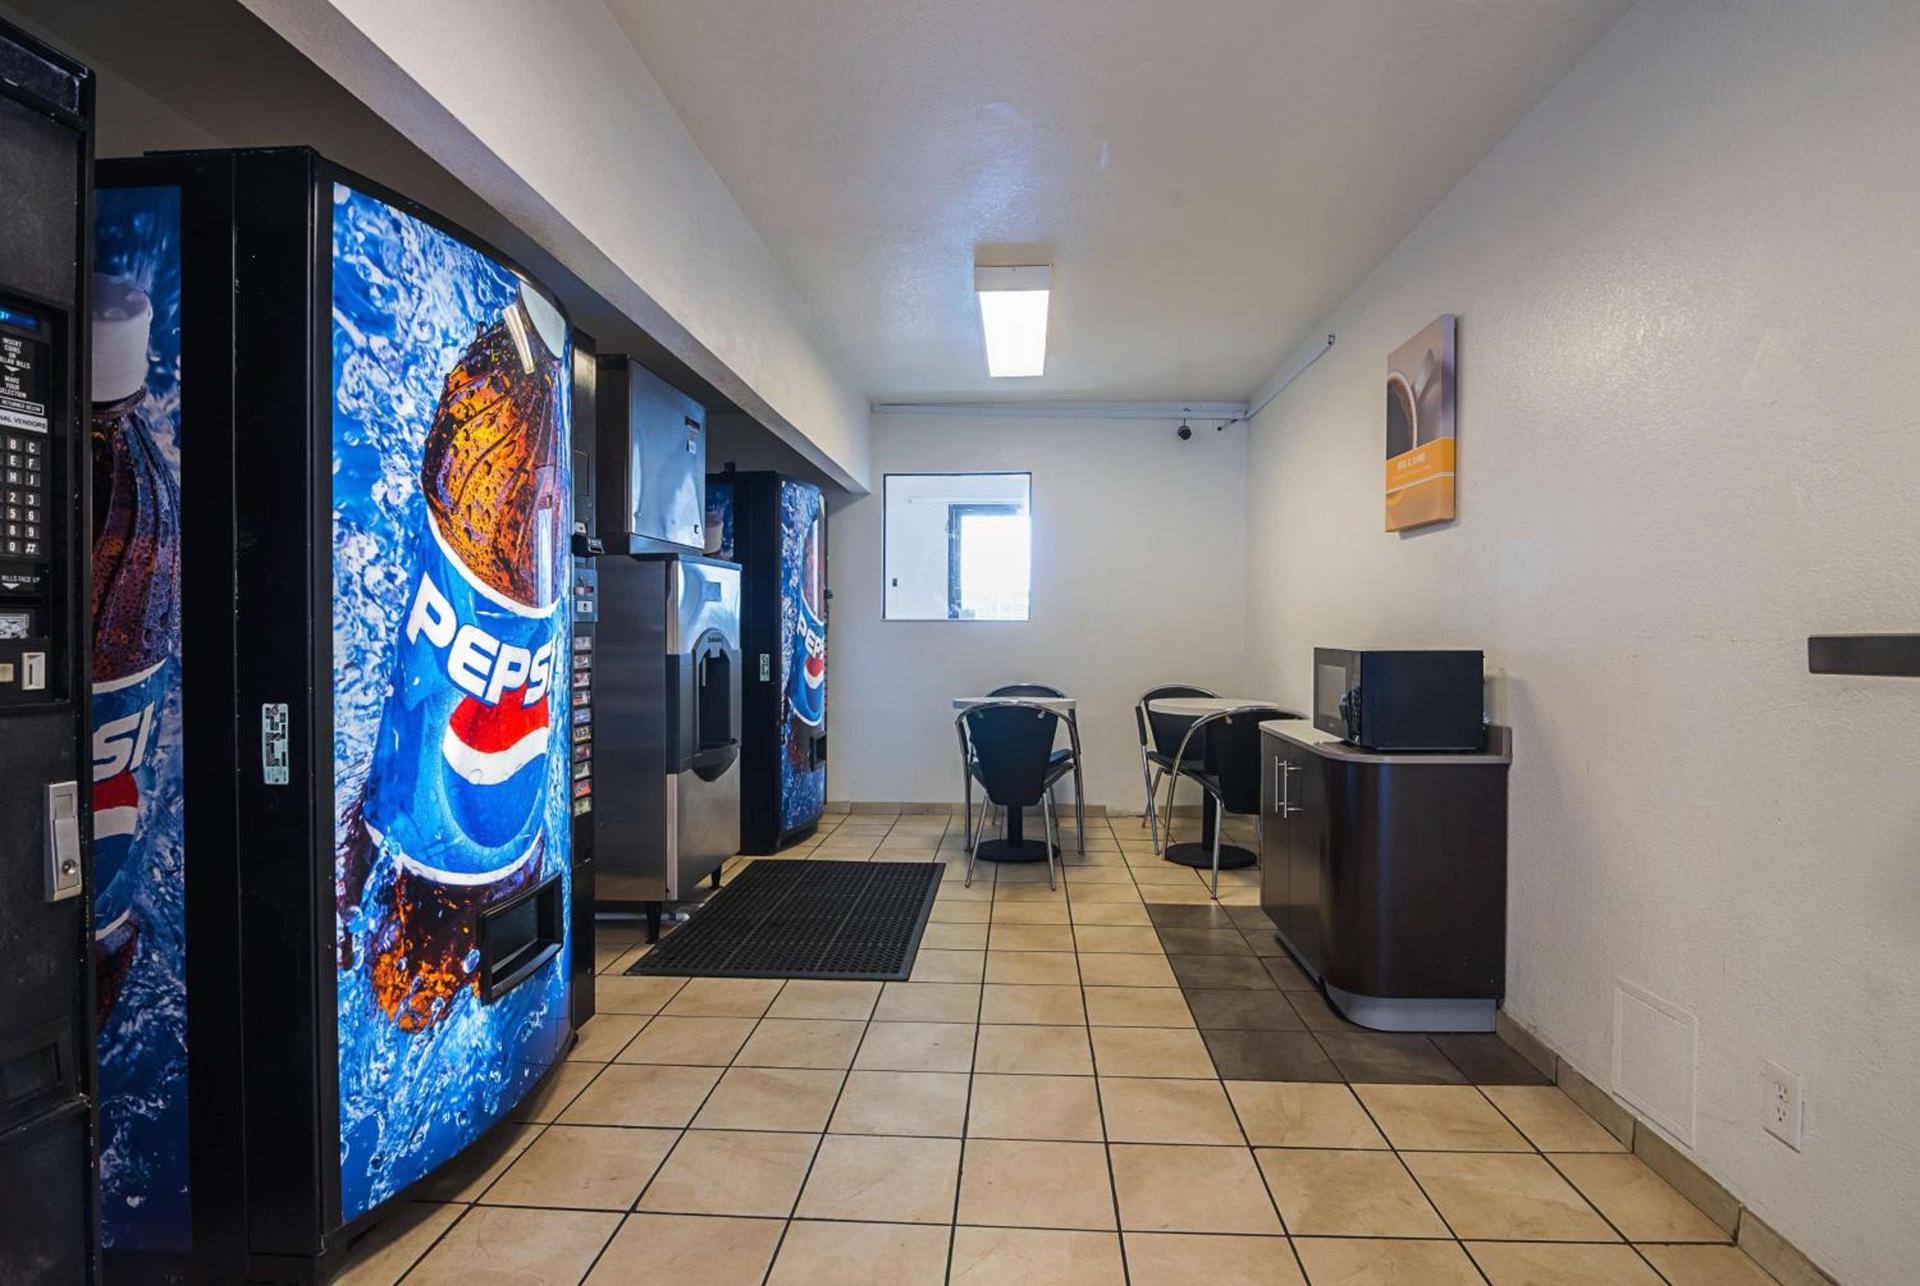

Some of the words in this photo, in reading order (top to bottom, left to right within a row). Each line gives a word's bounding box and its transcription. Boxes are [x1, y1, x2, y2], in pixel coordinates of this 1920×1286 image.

[2, 337, 22, 347] INSERT
[4, 375, 20, 384] MAKE
[5, 382, 20, 391] YOUR
[13, 416, 47, 430] VENDORS
[10, 439, 17, 450] B
[28, 441, 36, 453] C
[10, 455, 17, 467] E
[28, 458, 35, 470] F
[10, 471, 17, 482] H
[10, 492, 16, 503] 2
[28, 494, 35, 506] 3
[10, 508, 17, 520] 5
[28, 510, 35, 521] 6
[9, 524, 16, 536] 8
[28, 526, 35, 537] 9
